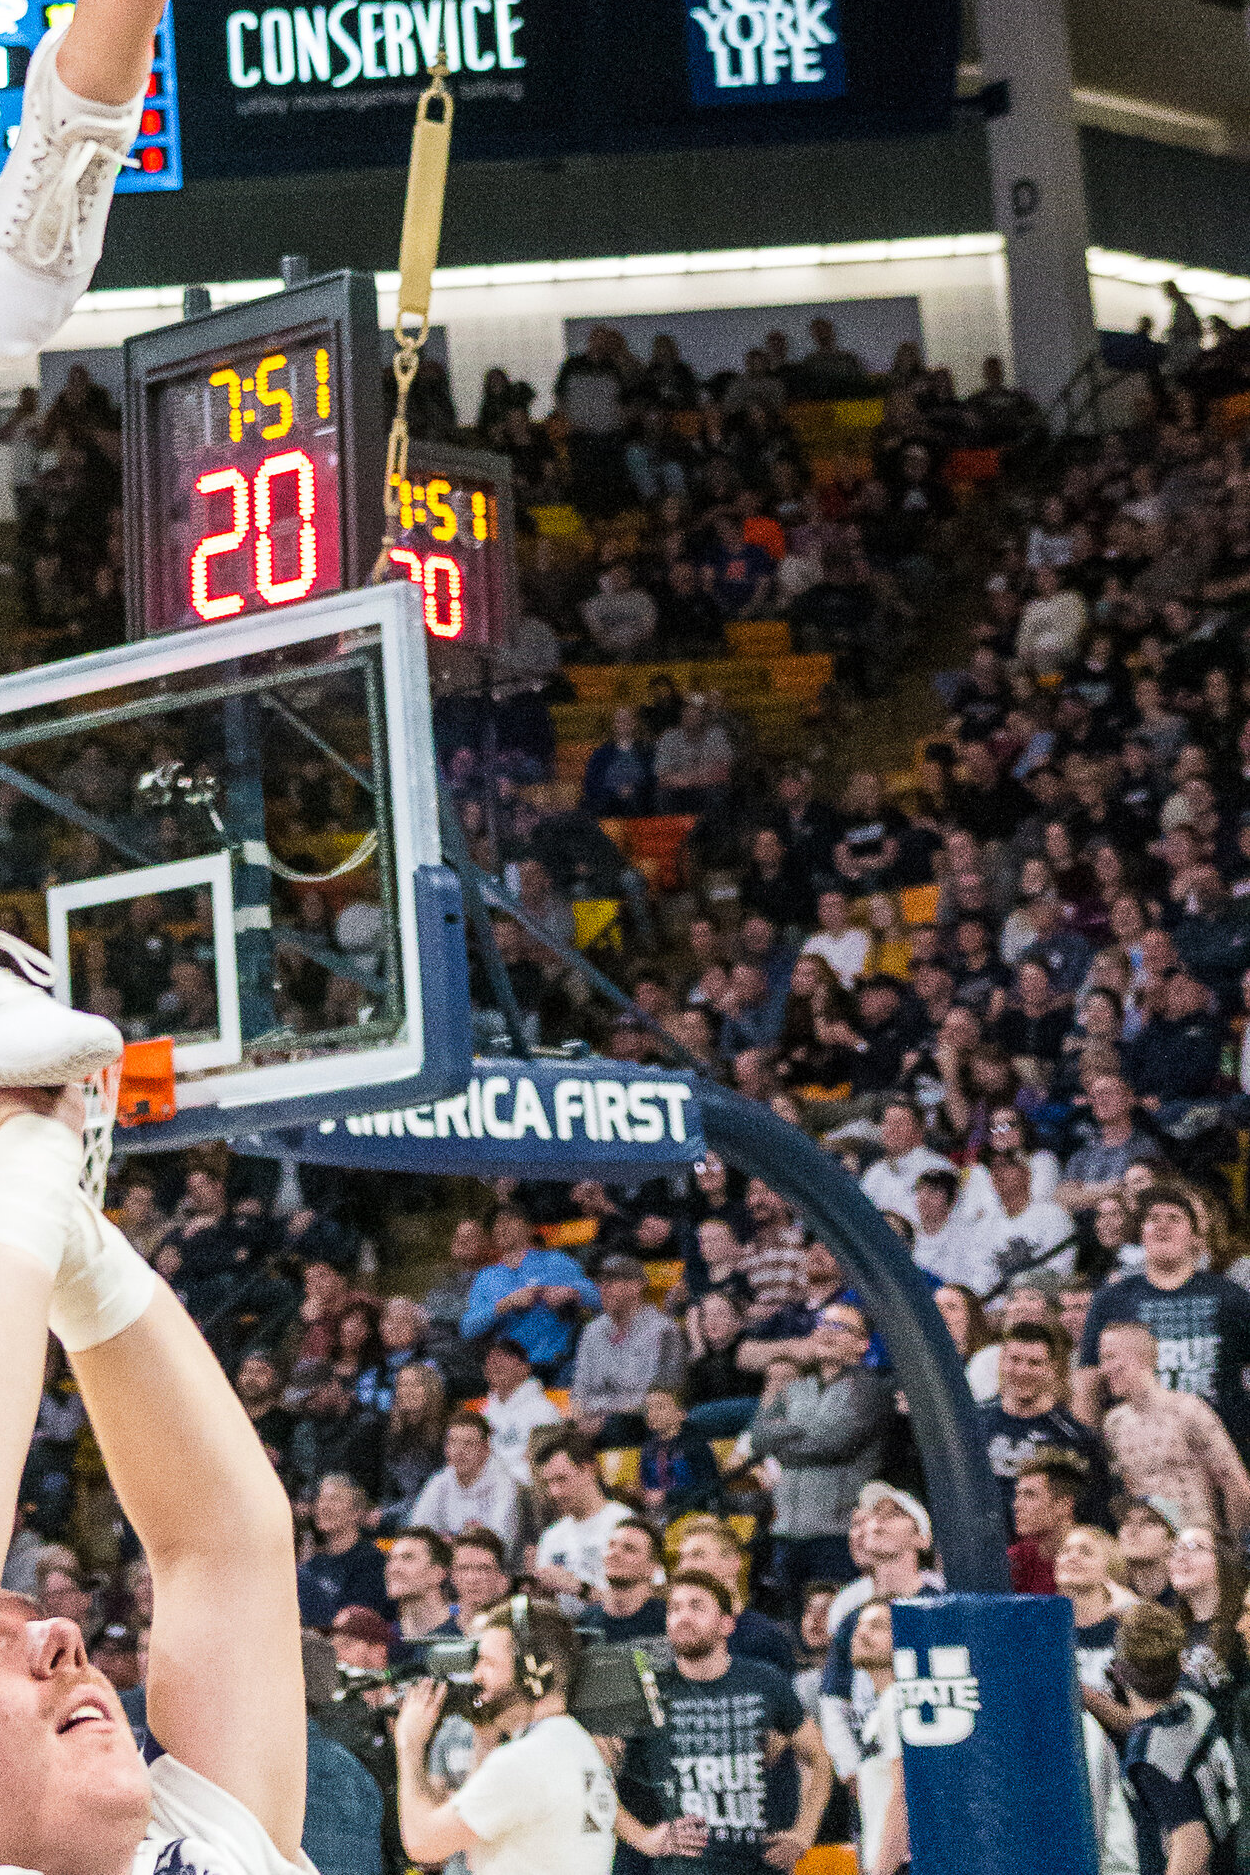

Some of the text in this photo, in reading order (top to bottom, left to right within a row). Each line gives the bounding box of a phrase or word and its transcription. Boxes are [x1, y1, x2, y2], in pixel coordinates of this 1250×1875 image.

[714, 45, 826, 89] LIFE
[209, 347, 331, 443] 7:51
[190, 447, 317, 622] 20
[554, 1078, 693, 1144] FIRST
[670, 1751, 767, 1793] TRUE
